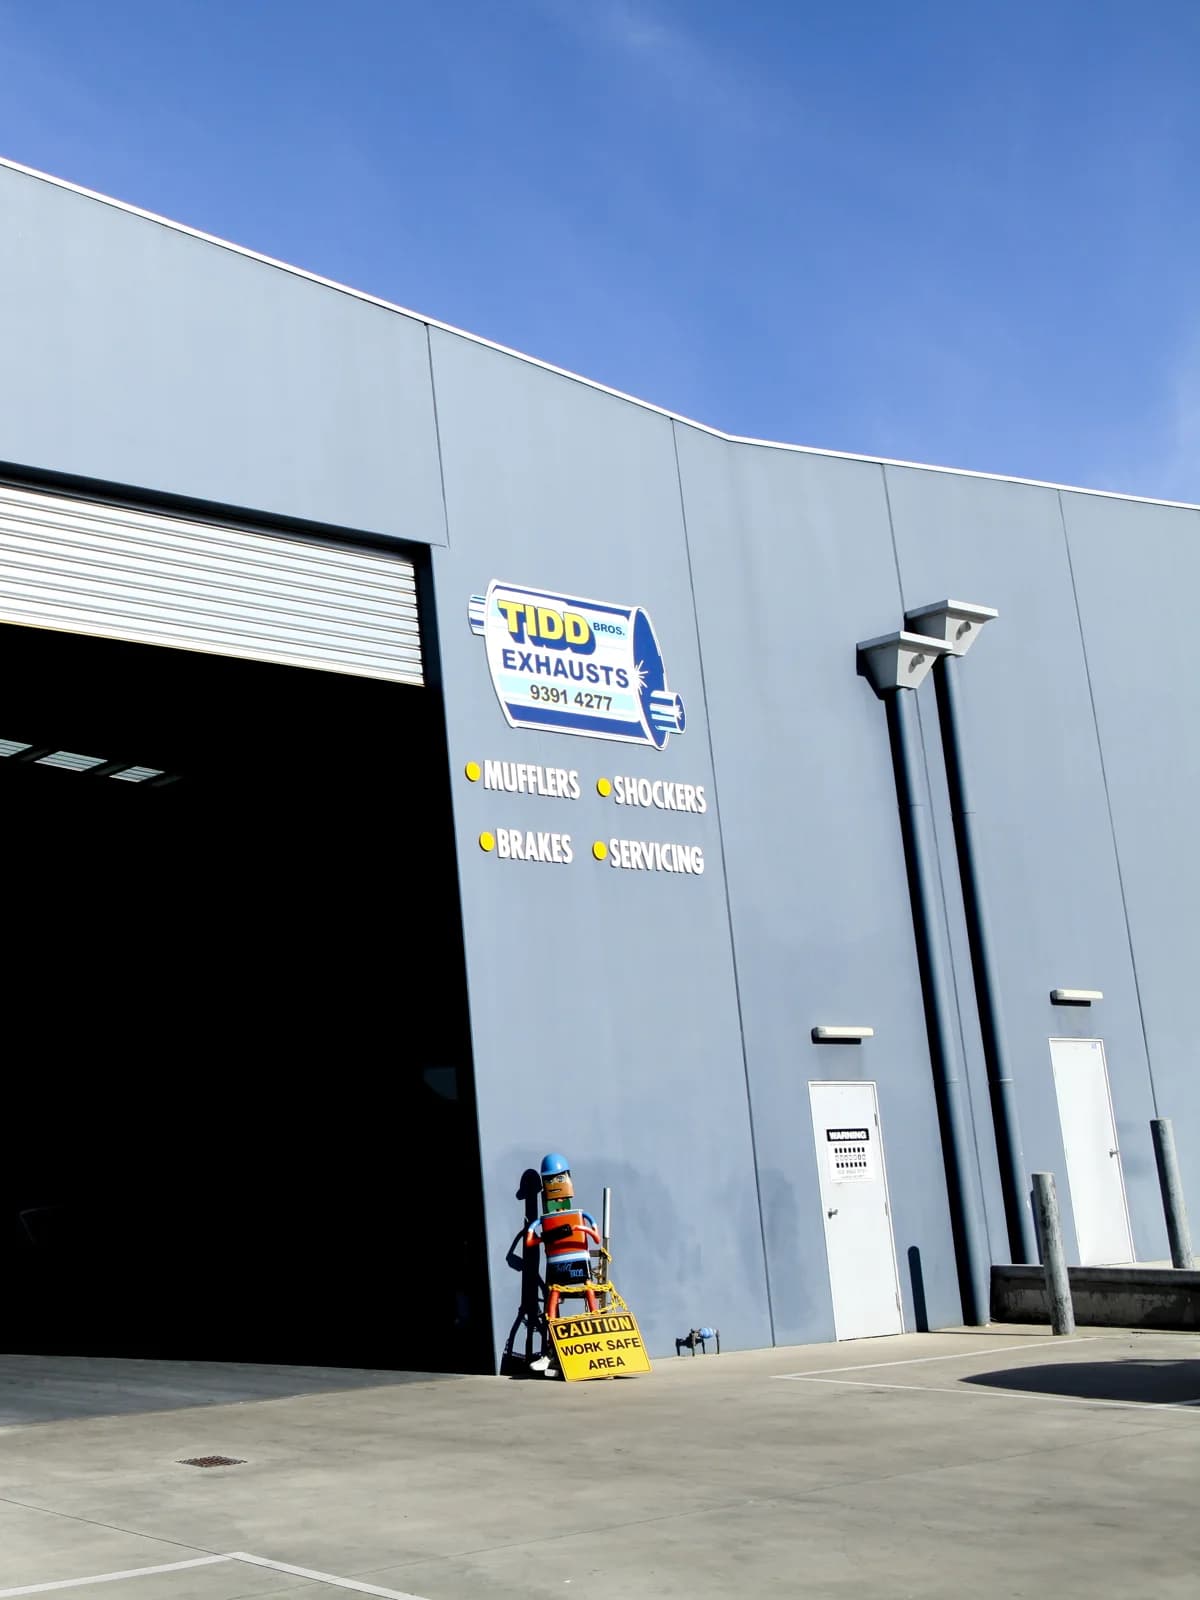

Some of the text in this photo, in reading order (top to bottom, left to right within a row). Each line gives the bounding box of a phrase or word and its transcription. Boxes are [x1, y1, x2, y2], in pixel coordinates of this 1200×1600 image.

[497, 599, 625, 655] TIDD BROS.
[502, 648, 629, 689] EXHAUSTS
[530, 684, 612, 711] 9391 4277
[483, 760, 581, 800] MUFFLERS
[613, 776, 707, 814] SHOCKERS
[496, 828, 573, 864] BRAKES
[609, 838, 705, 876] SERVICING
[556, 1317, 633, 1339] CAUTION
[560, 1337, 641, 1356] WORK SAFE
[588, 1357, 626, 1371] AREA
